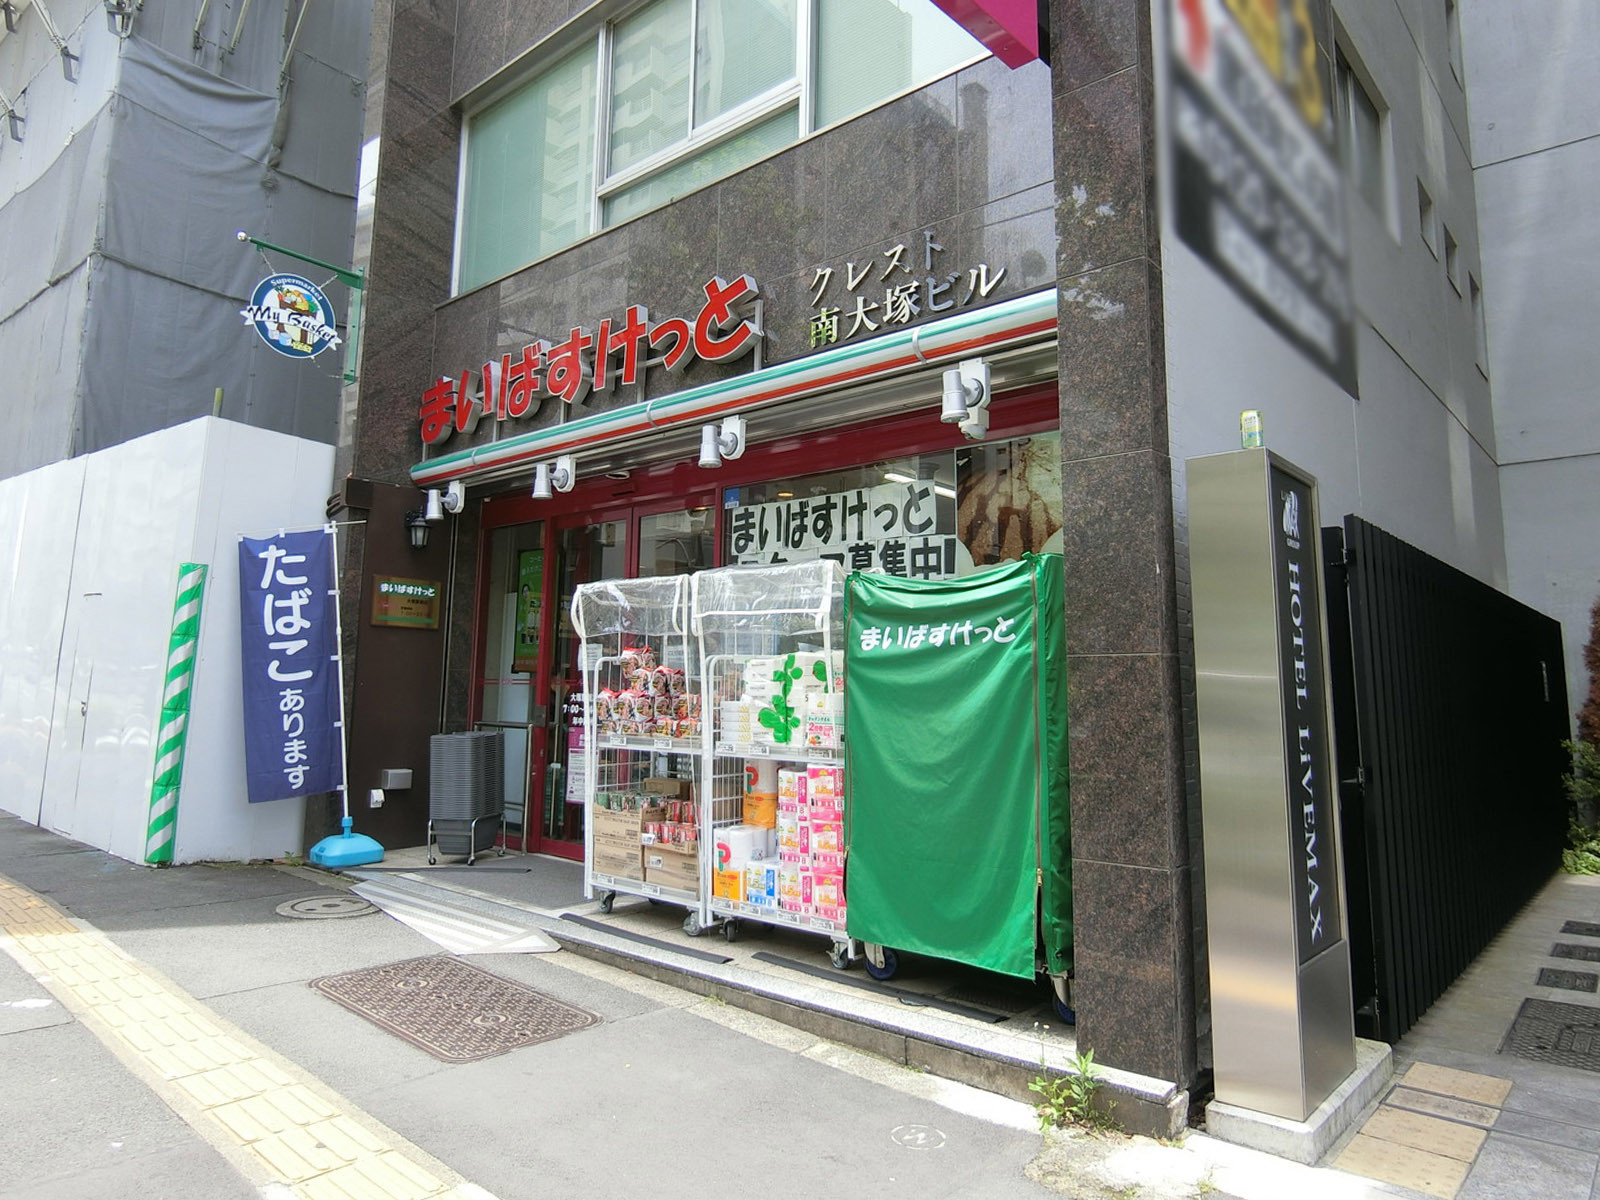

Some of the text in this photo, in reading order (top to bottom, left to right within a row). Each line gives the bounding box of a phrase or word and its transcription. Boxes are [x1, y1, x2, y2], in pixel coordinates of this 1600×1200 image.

[271, 277, 323, 301] Supermarket
[810, 230, 944, 306] クレスト
[247, 305, 336, 342] My Basket
[809, 263, 1006, 348] 南大塚ビル
[420, 273, 764, 444] まいばすけっと
[733, 483, 934, 554] まいばすけっと
[380, 582, 436, 597] まいばすけっと
[860, 616, 1017, 651] まいばすけっと
[1288, 560, 1308, 710] HOTEL
